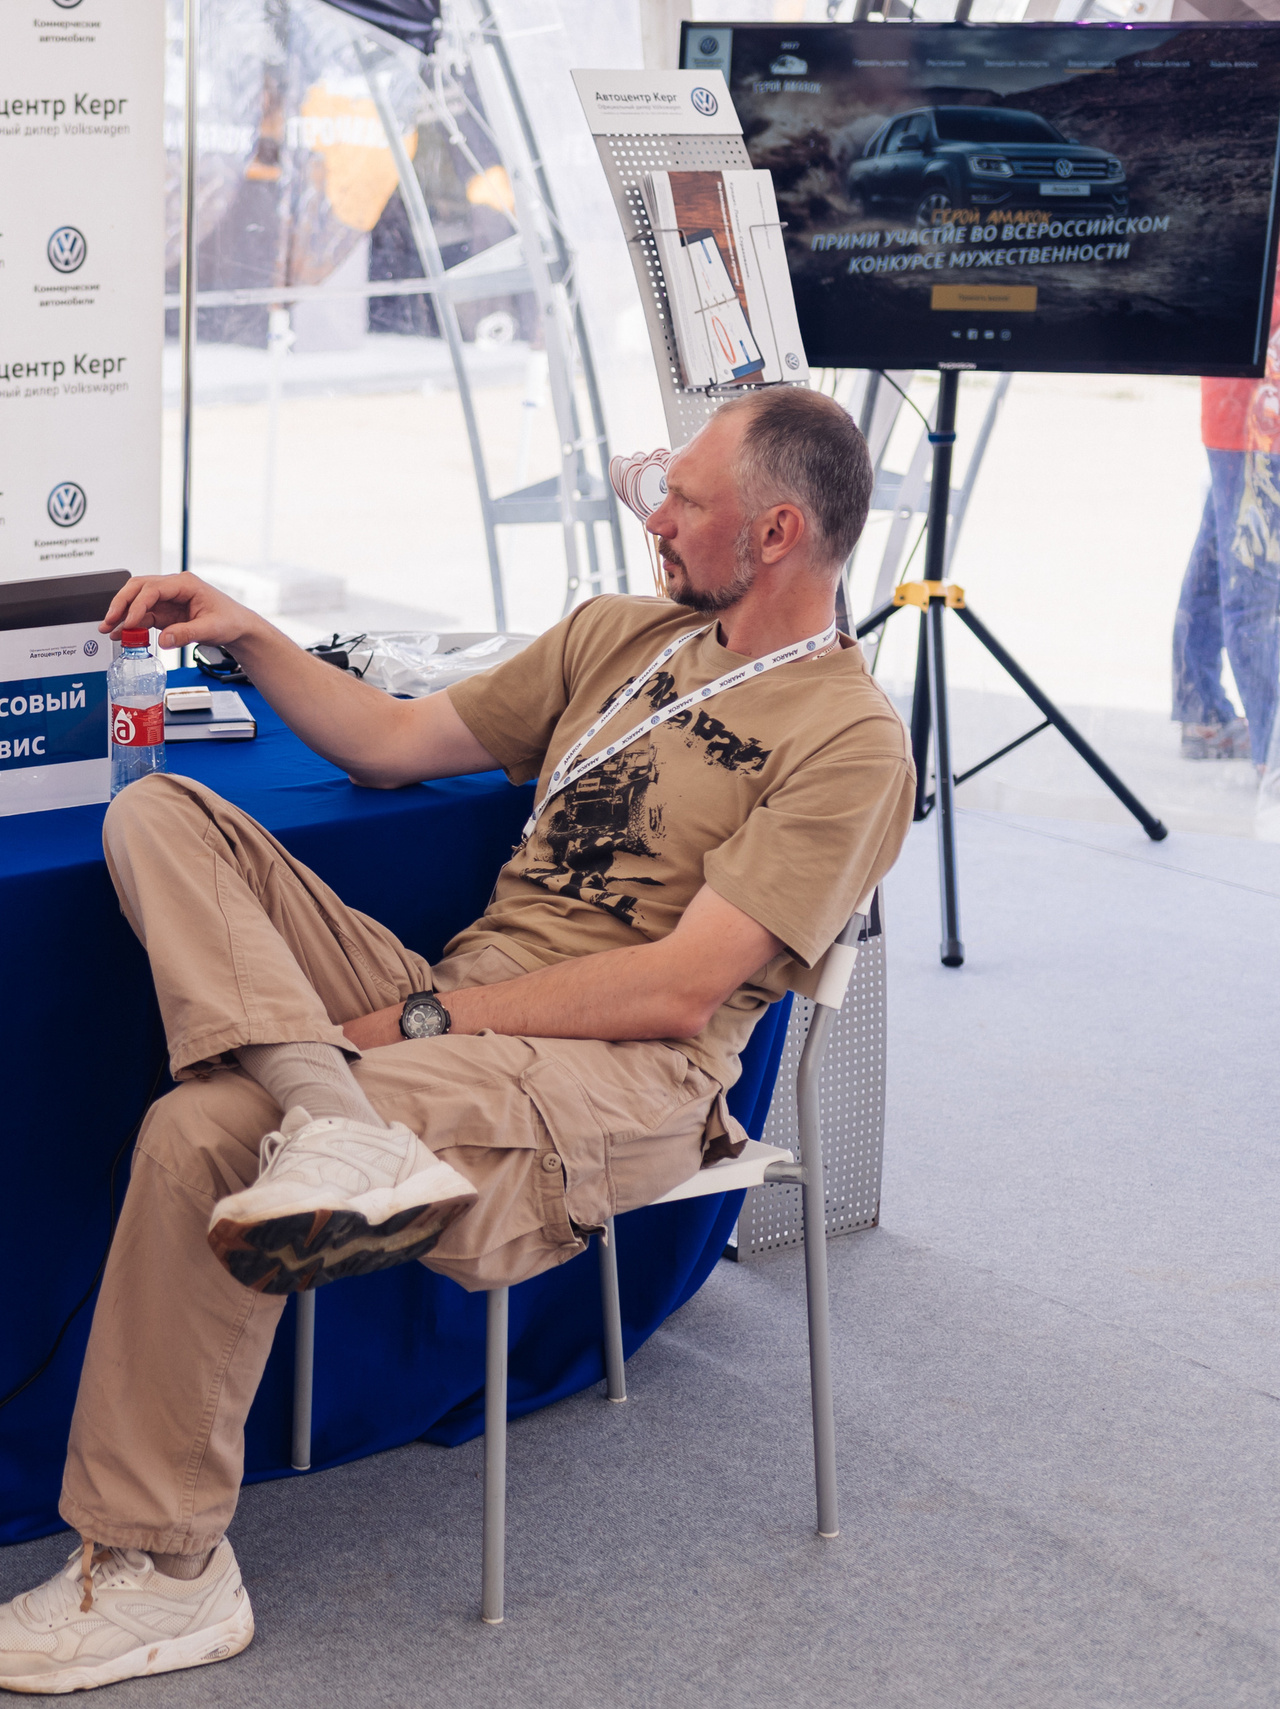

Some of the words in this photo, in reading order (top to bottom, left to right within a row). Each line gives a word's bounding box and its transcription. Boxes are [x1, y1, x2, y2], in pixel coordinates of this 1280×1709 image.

[75, 93, 127, 119] Керг
[596, 92, 654, 103] Автоцентр
[650, 93, 676, 103] Керг
[24, 126, 60, 137] дилер
[59, 123, 130, 138] Volkswagen
[931, 207, 981, 225] ГЕРОЙ
[811, 231, 881, 251] ПРИМИ
[884, 225, 967, 248] УЧАСТИЕ
[971, 225, 998, 243] ВО
[1002, 214, 1170, 241] ВСЕРОССИЙСКОМ
[848, 252, 946, 274] КОНКУРСЕ
[949, 242, 1131, 268] МУЖЕСТВЕННОСТИ
[74, 354, 126, 378] Керг
[24, 386, 59, 398] дилер
[63, 382, 129, 395] Volkswagen
[60, 647, 76, 655] Керг
